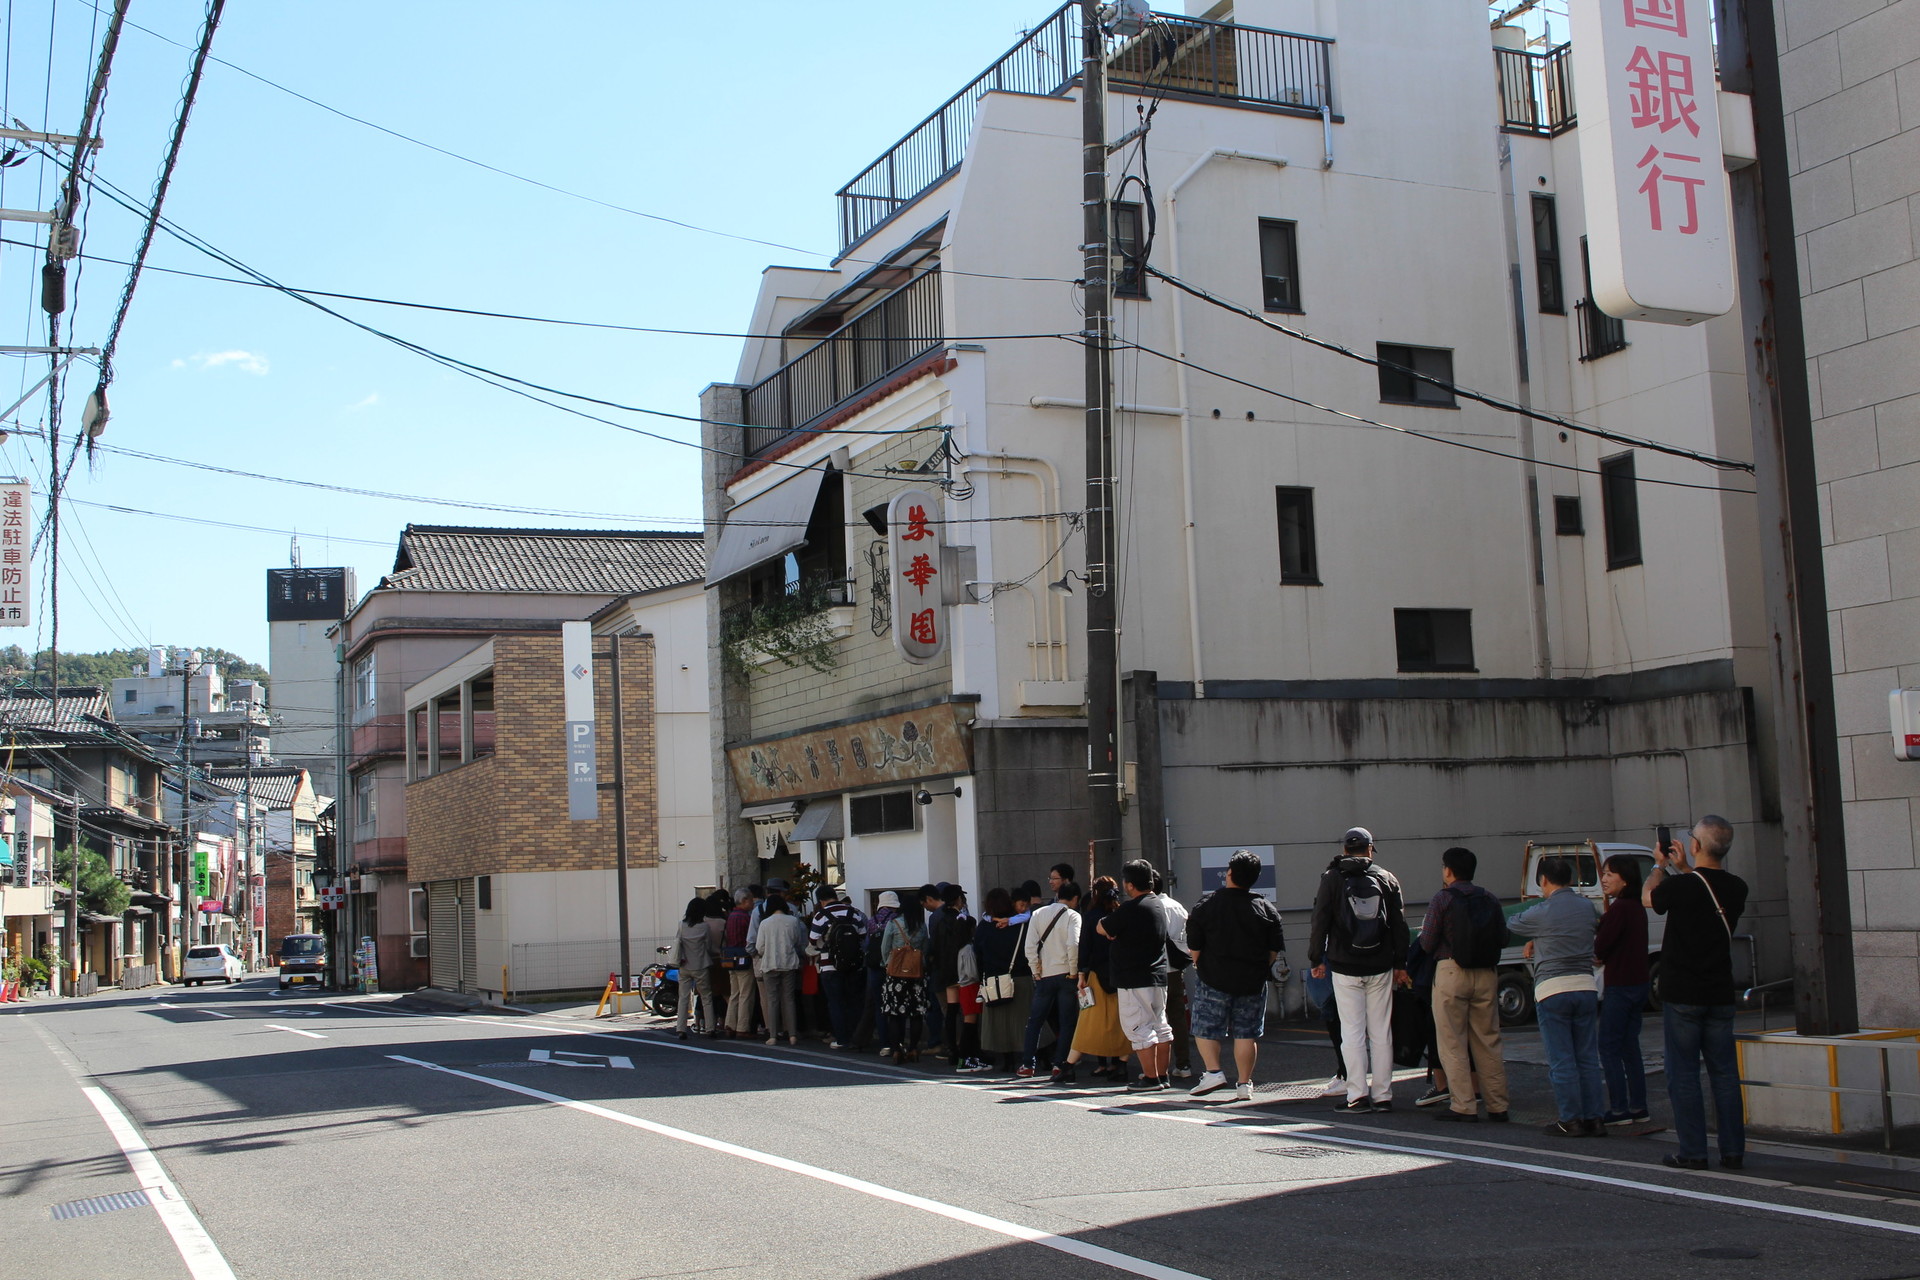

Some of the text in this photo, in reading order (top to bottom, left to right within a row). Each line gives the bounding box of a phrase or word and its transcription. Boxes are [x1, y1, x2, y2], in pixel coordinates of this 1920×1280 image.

[2, 490, 23, 604] 違法駐車防止
[573, 724, 590, 742] P
[16, 830, 28, 887] 金野美容室
